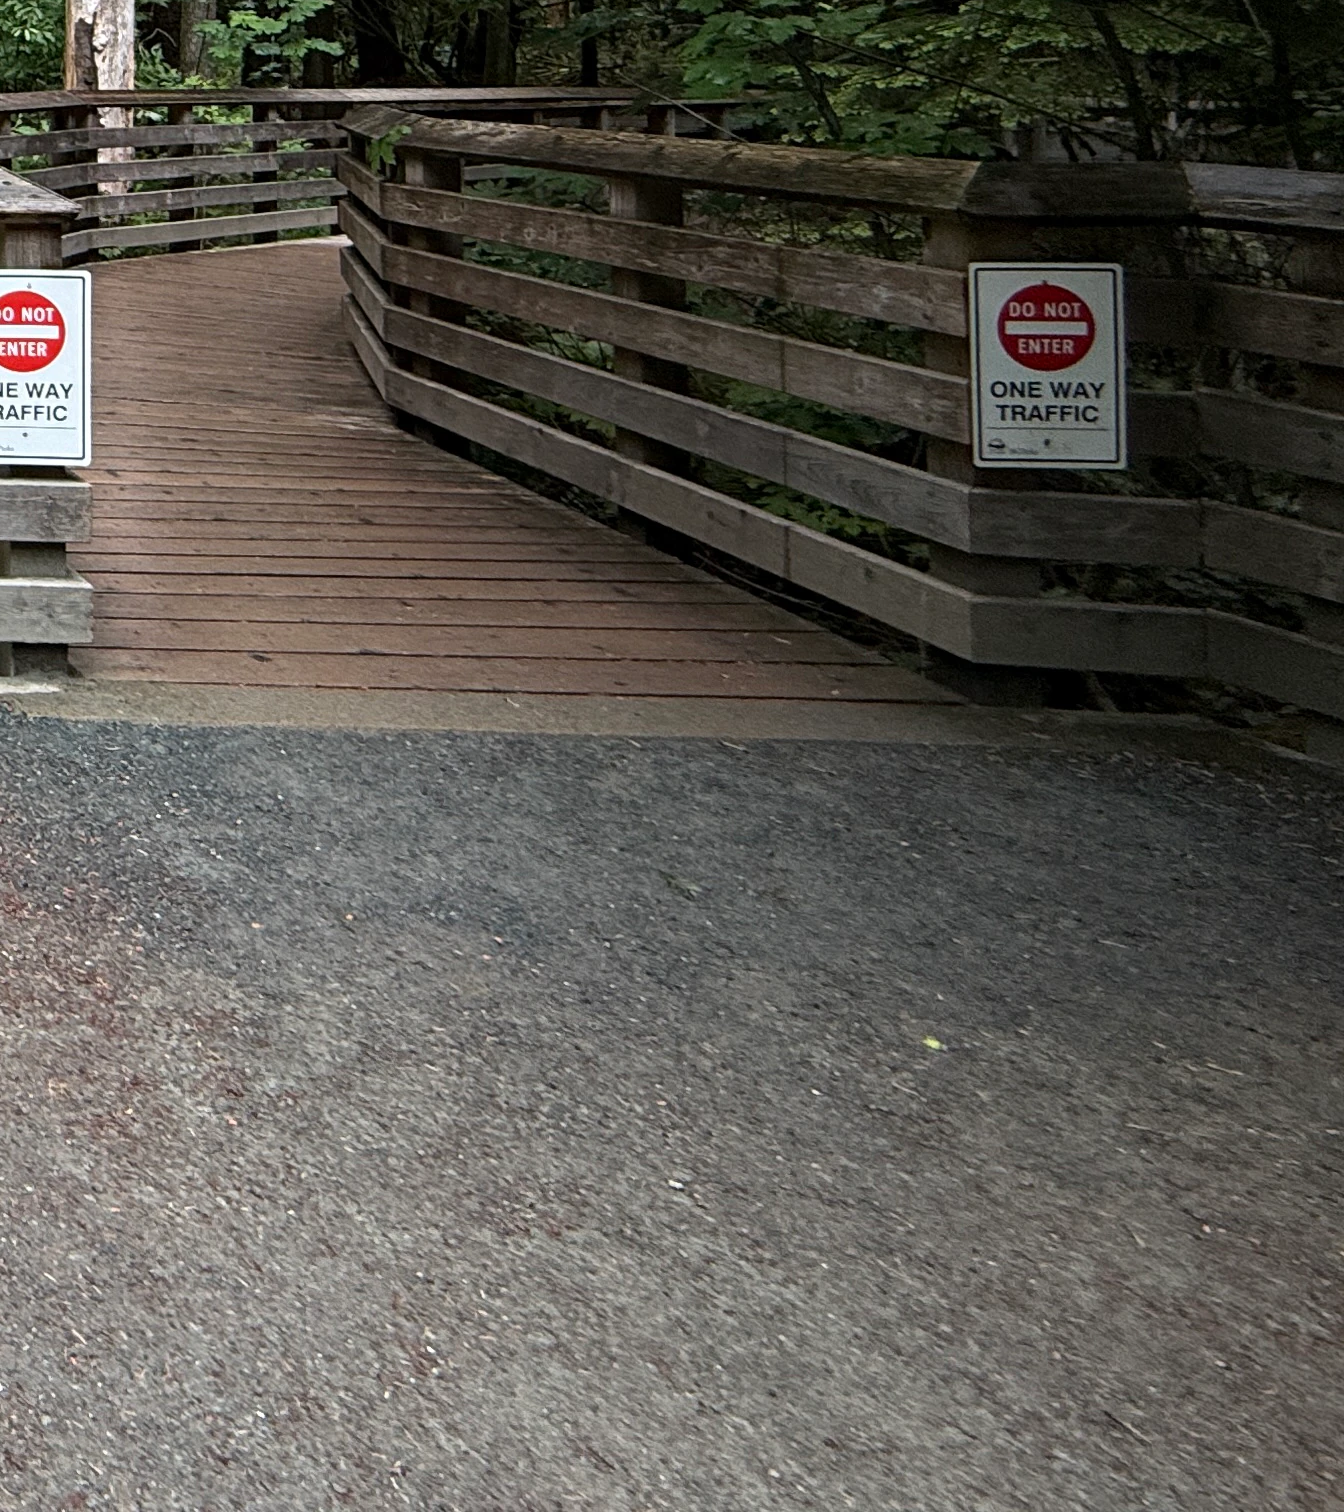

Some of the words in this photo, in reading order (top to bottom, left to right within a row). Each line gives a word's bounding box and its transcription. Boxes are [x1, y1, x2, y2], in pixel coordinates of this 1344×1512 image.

[21, 307, 55, 323] NOT
[1008, 302, 1035, 318] DO
[1044, 302, 1082, 318] NOT
[1018, 338, 1075, 354] ENTER
[25, 383, 73, 399] WAY
[990, 381, 1043, 399] ONE
[1050, 382, 1105, 399] WAY
[996, 404, 1099, 423] TRAFFIC
